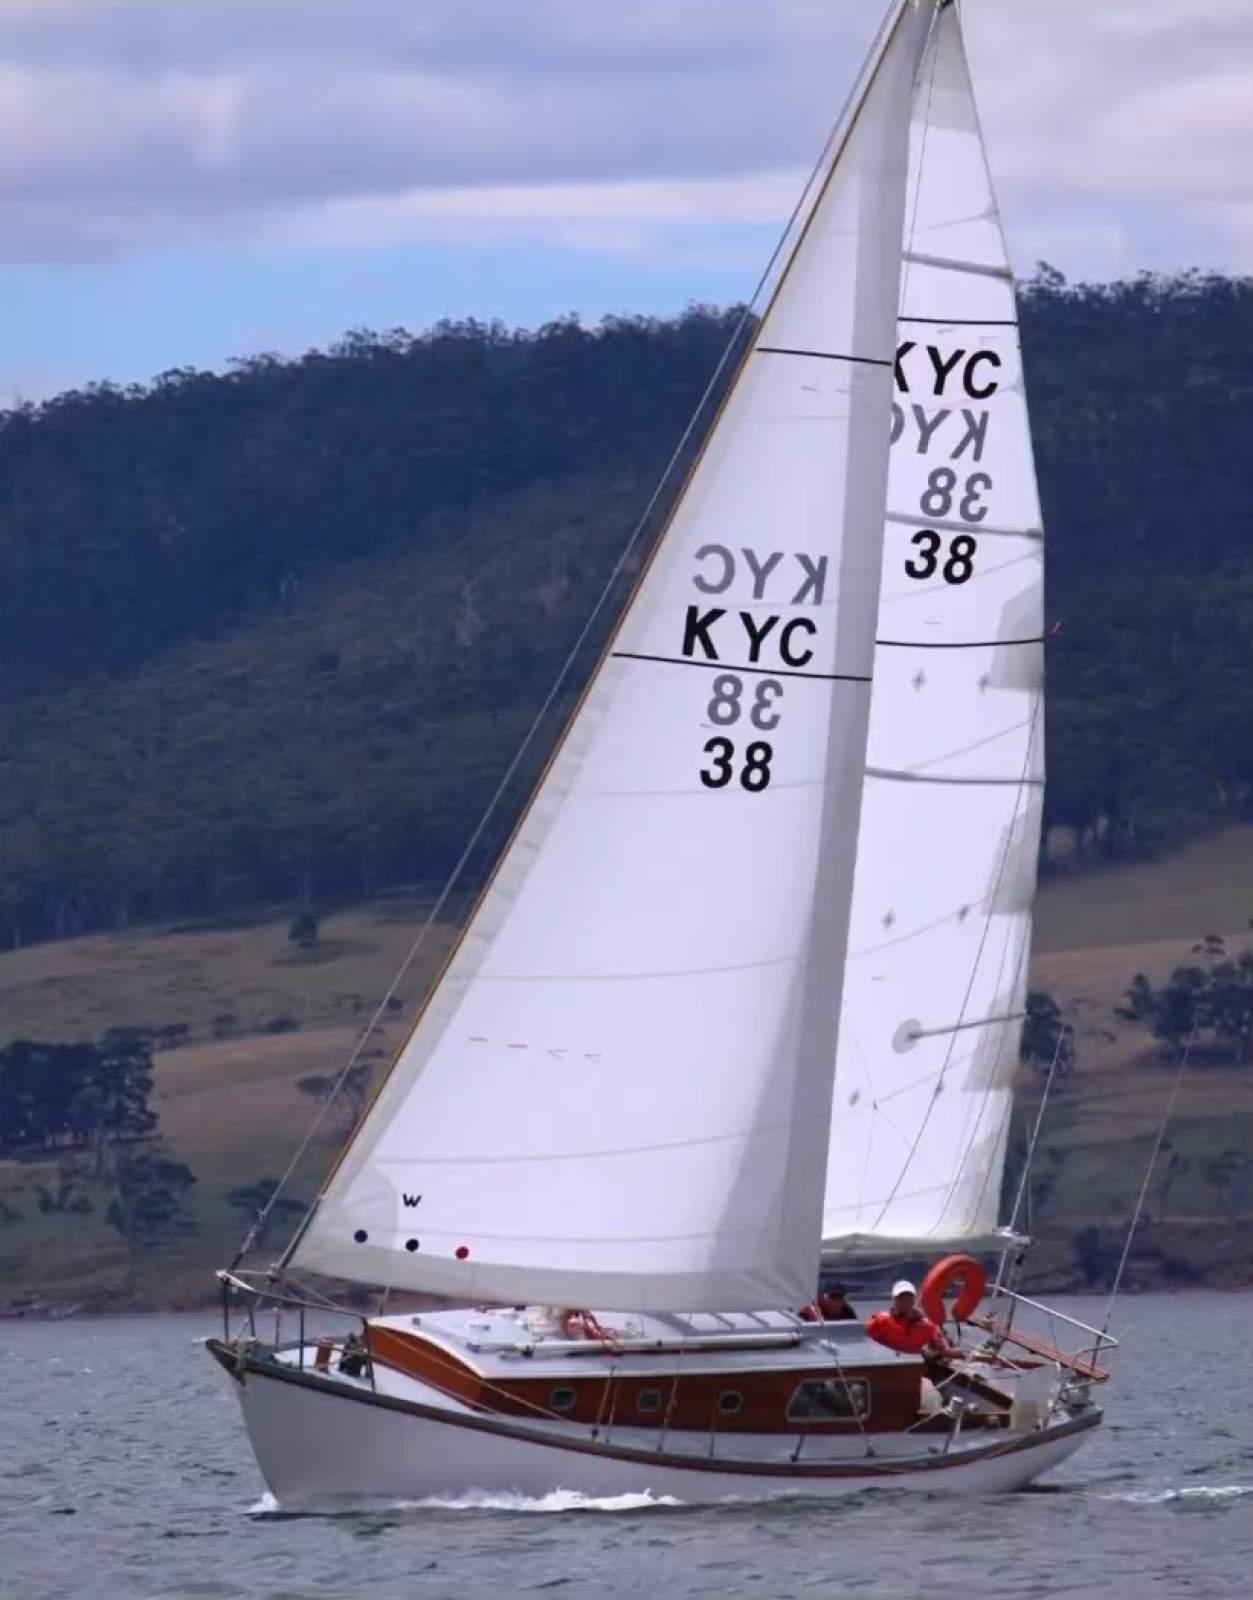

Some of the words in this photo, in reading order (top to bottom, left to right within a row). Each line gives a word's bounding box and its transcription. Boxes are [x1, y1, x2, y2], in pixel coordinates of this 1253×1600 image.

[894, 341, 1001, 400] KYC
[905, 529, 977, 585] 38
[682, 605, 817, 668] KYC
[700, 736, 773, 792] 38
